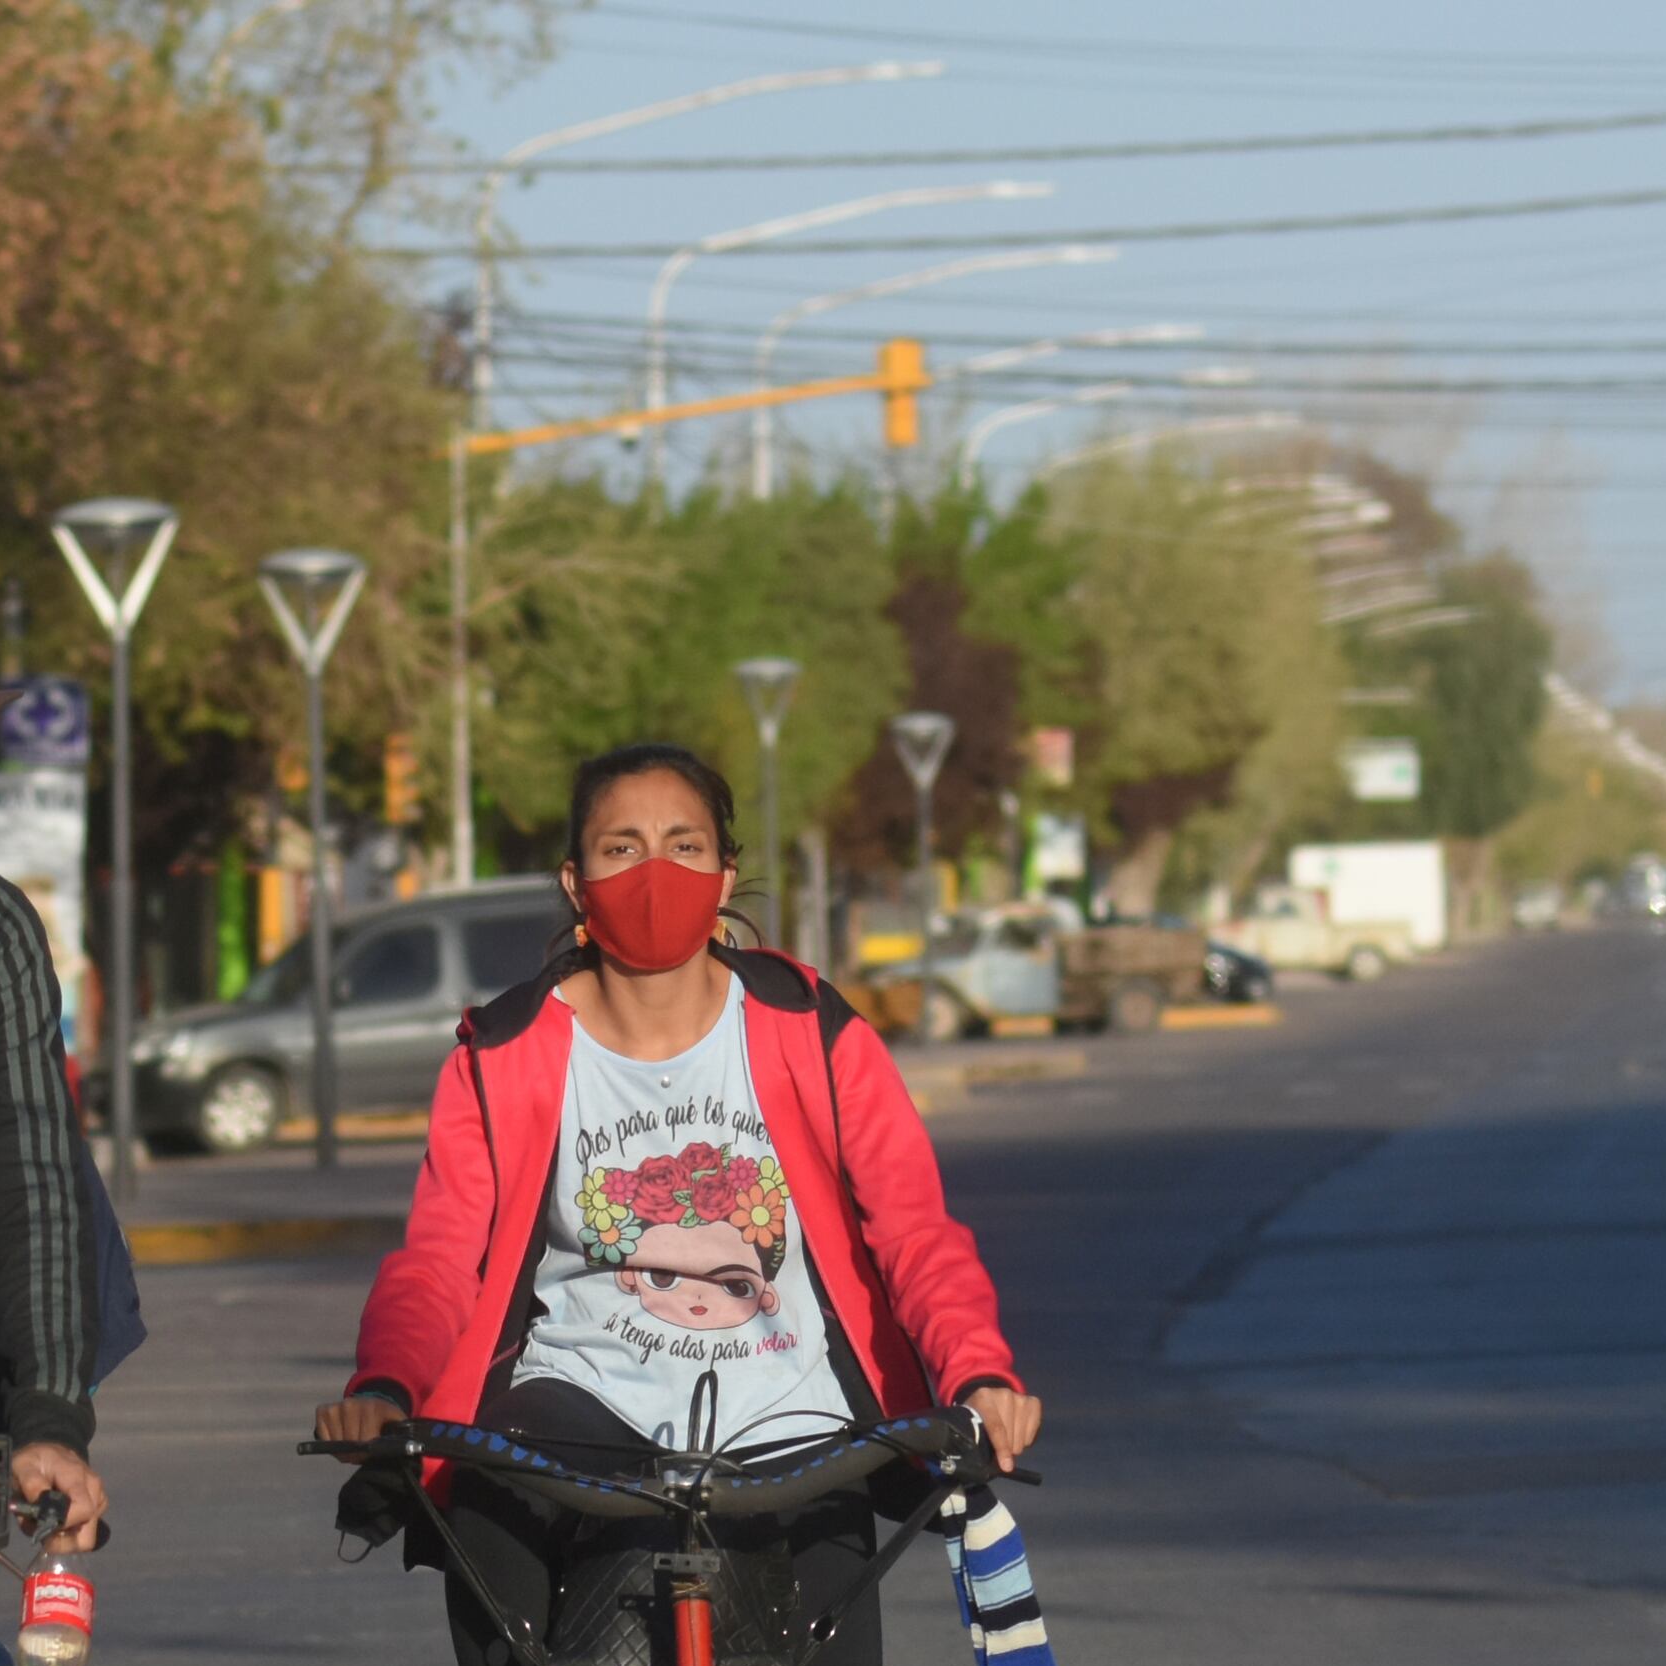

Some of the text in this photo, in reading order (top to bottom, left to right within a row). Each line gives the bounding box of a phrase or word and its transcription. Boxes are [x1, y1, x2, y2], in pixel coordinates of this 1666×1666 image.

[575, 1126, 611, 1175] Pies
[615, 1110, 659, 1157] para
[665, 1096, 698, 1142] qué
[703, 1095, 727, 1127] los
[620, 1316, 666, 1365] tengo
[669, 1334, 708, 1360] alas
[709, 1339, 751, 1370] para
[755, 1330, 798, 1356] volar
